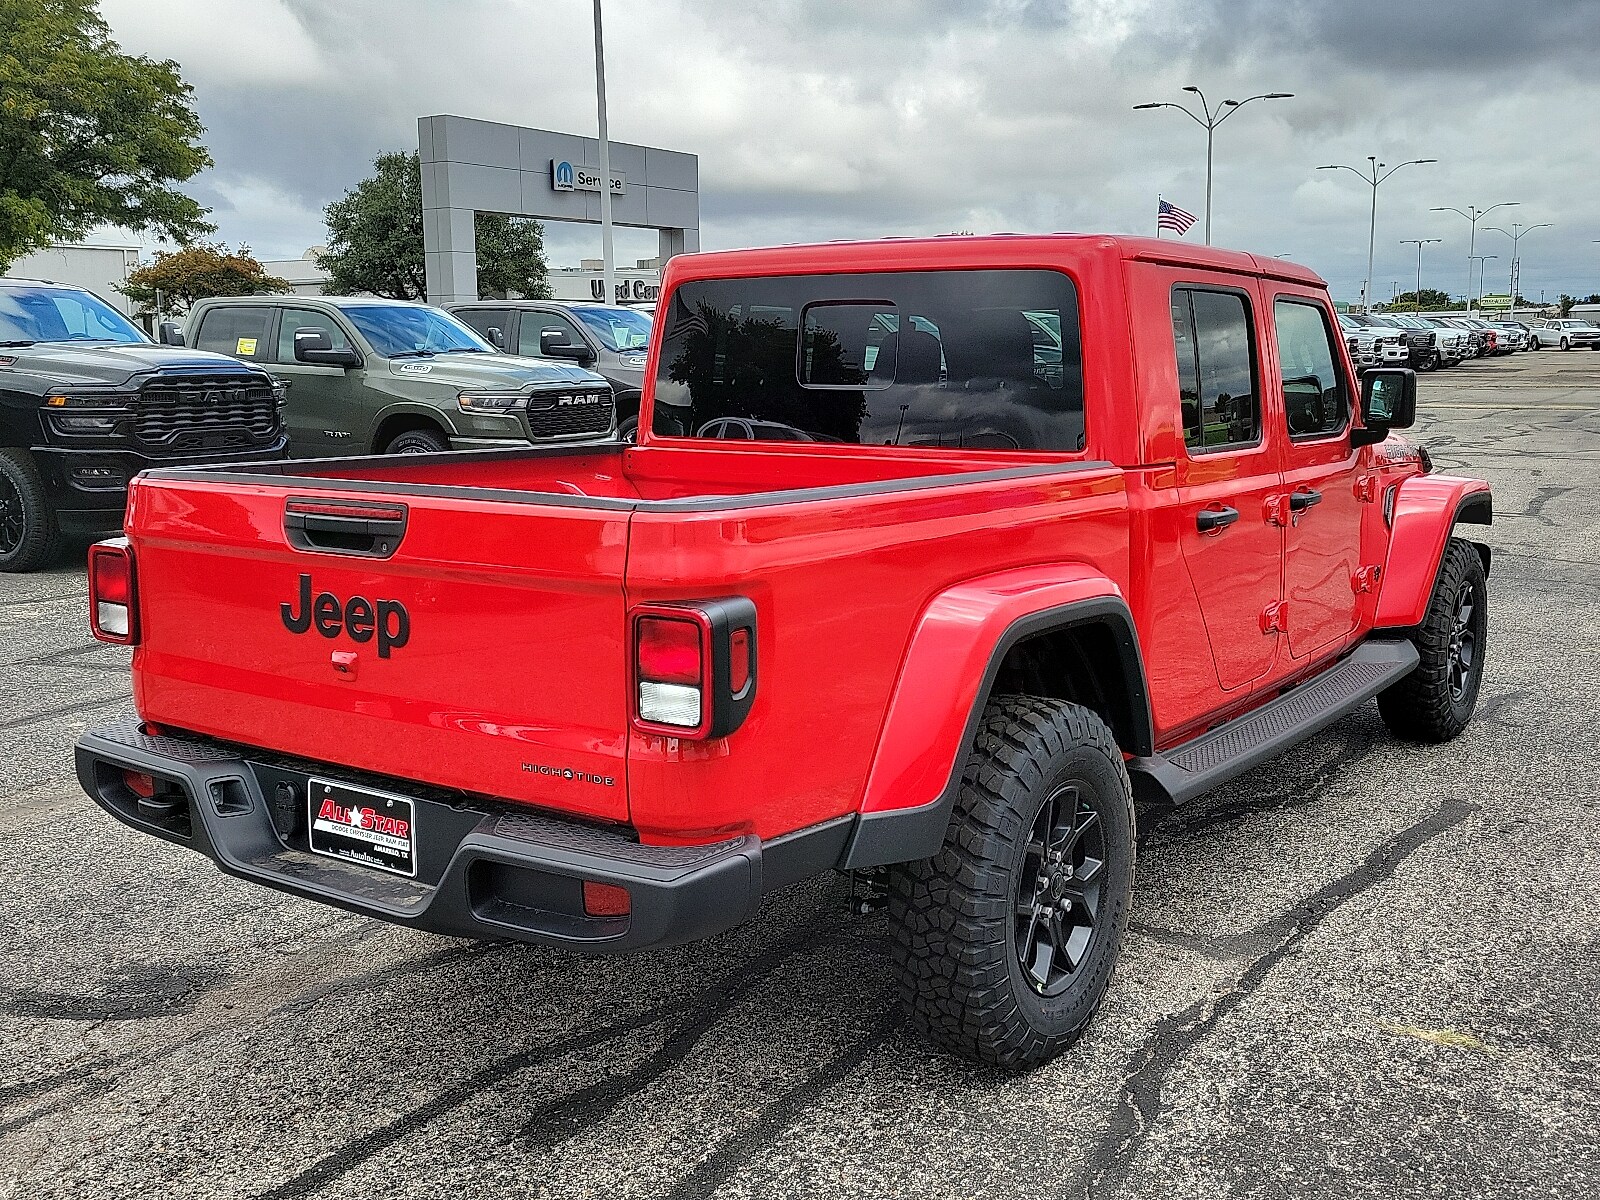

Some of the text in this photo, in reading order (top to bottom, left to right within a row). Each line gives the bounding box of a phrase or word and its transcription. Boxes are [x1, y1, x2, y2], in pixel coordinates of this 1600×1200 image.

[578, 171, 622, 189] Servce
[590, 279, 660, 299] Ued Car
[178, 389, 246, 403] RAM
[558, 394, 599, 406] RAM
[323, 430, 351, 438] RAM
[280, 573, 410, 659] Jeep
[521, 762, 615, 786] HIGH TIDE
[318, 798, 408, 839] ALL STAR
[331, 824, 349, 834] DODGE
[397, 840, 408, 848] FIAT
[401, 851, 409, 859] TX
